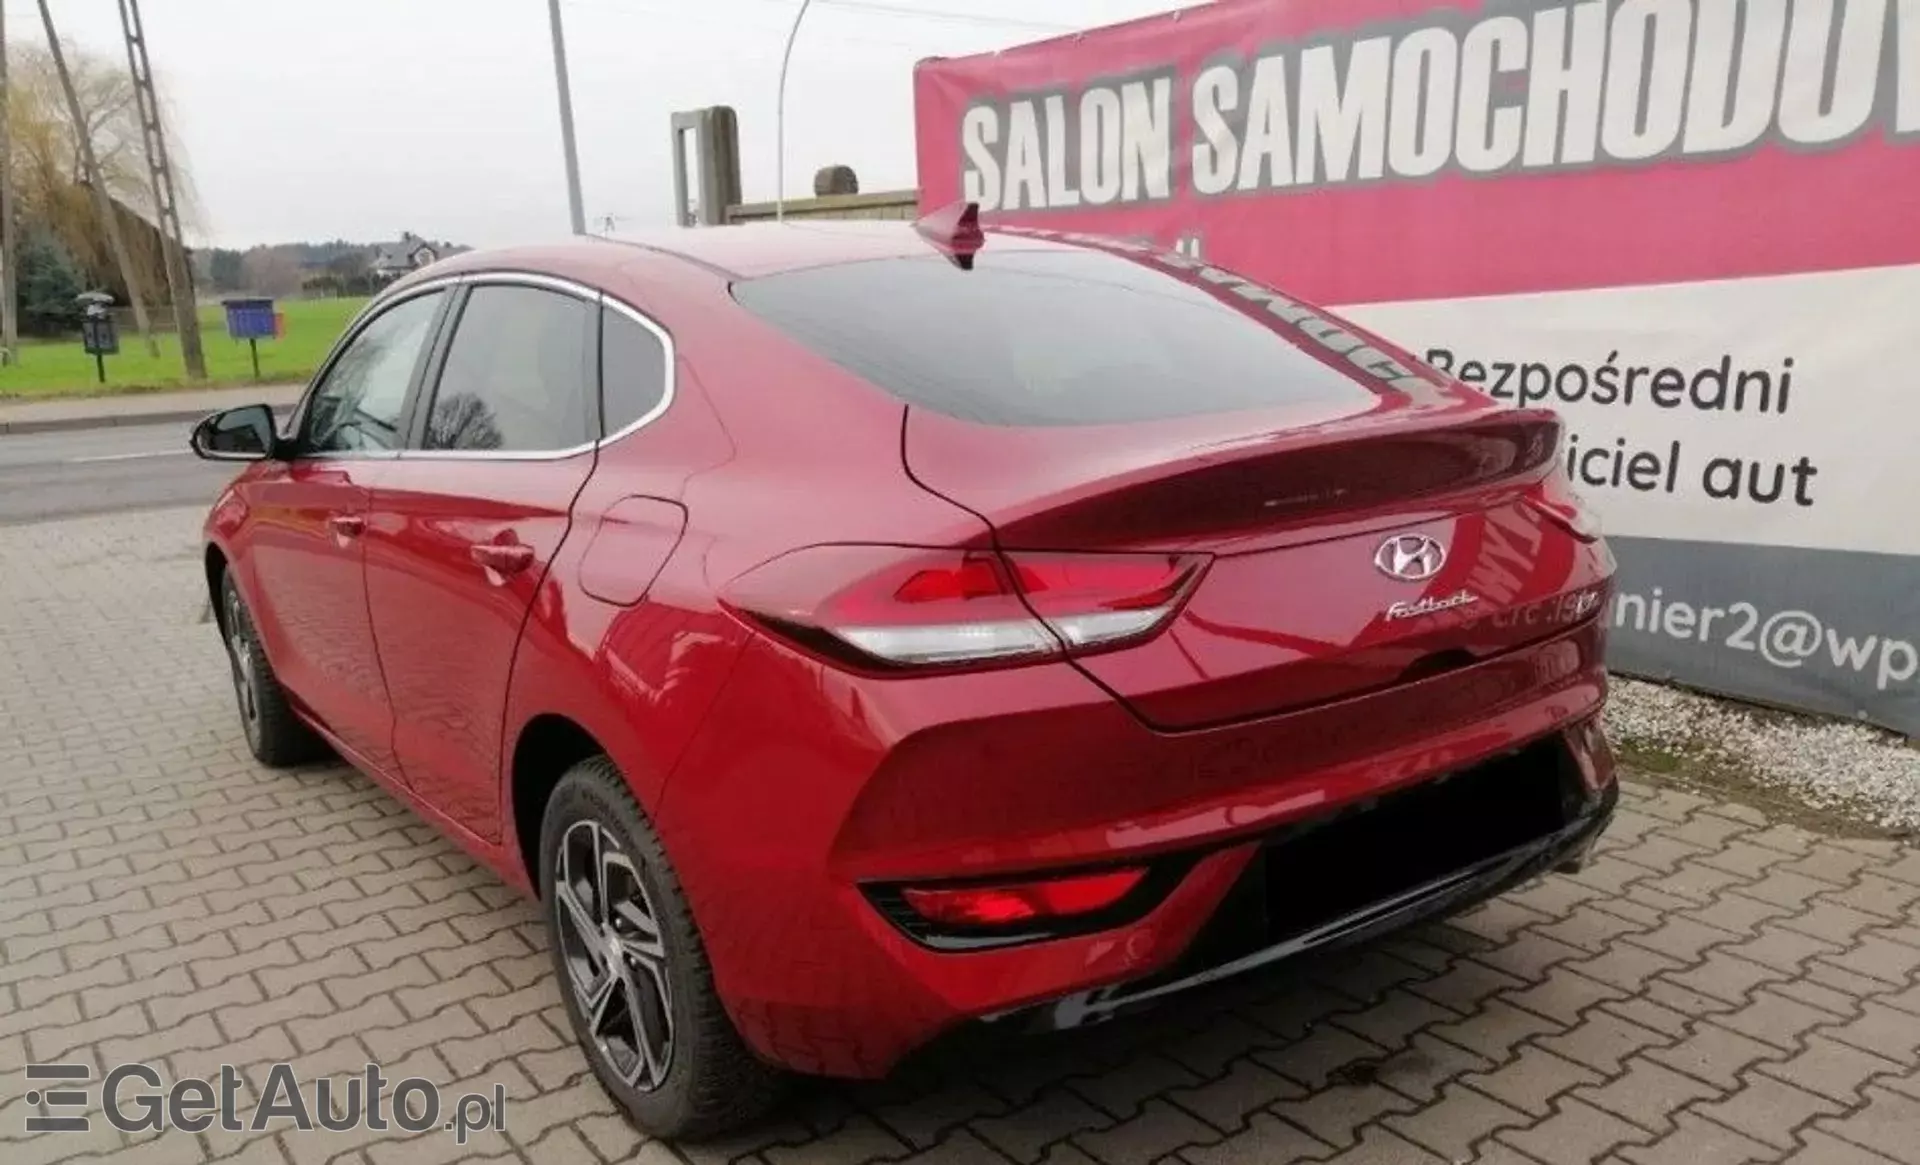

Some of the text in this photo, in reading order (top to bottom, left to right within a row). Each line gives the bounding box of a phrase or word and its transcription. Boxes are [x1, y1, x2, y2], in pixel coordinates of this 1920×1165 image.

[963, 0, 1920, 212] SALON SAMOCHODO
[1567, 433, 1818, 507] iciel aut
[1615, 588, 1920, 690] nier2@wp
